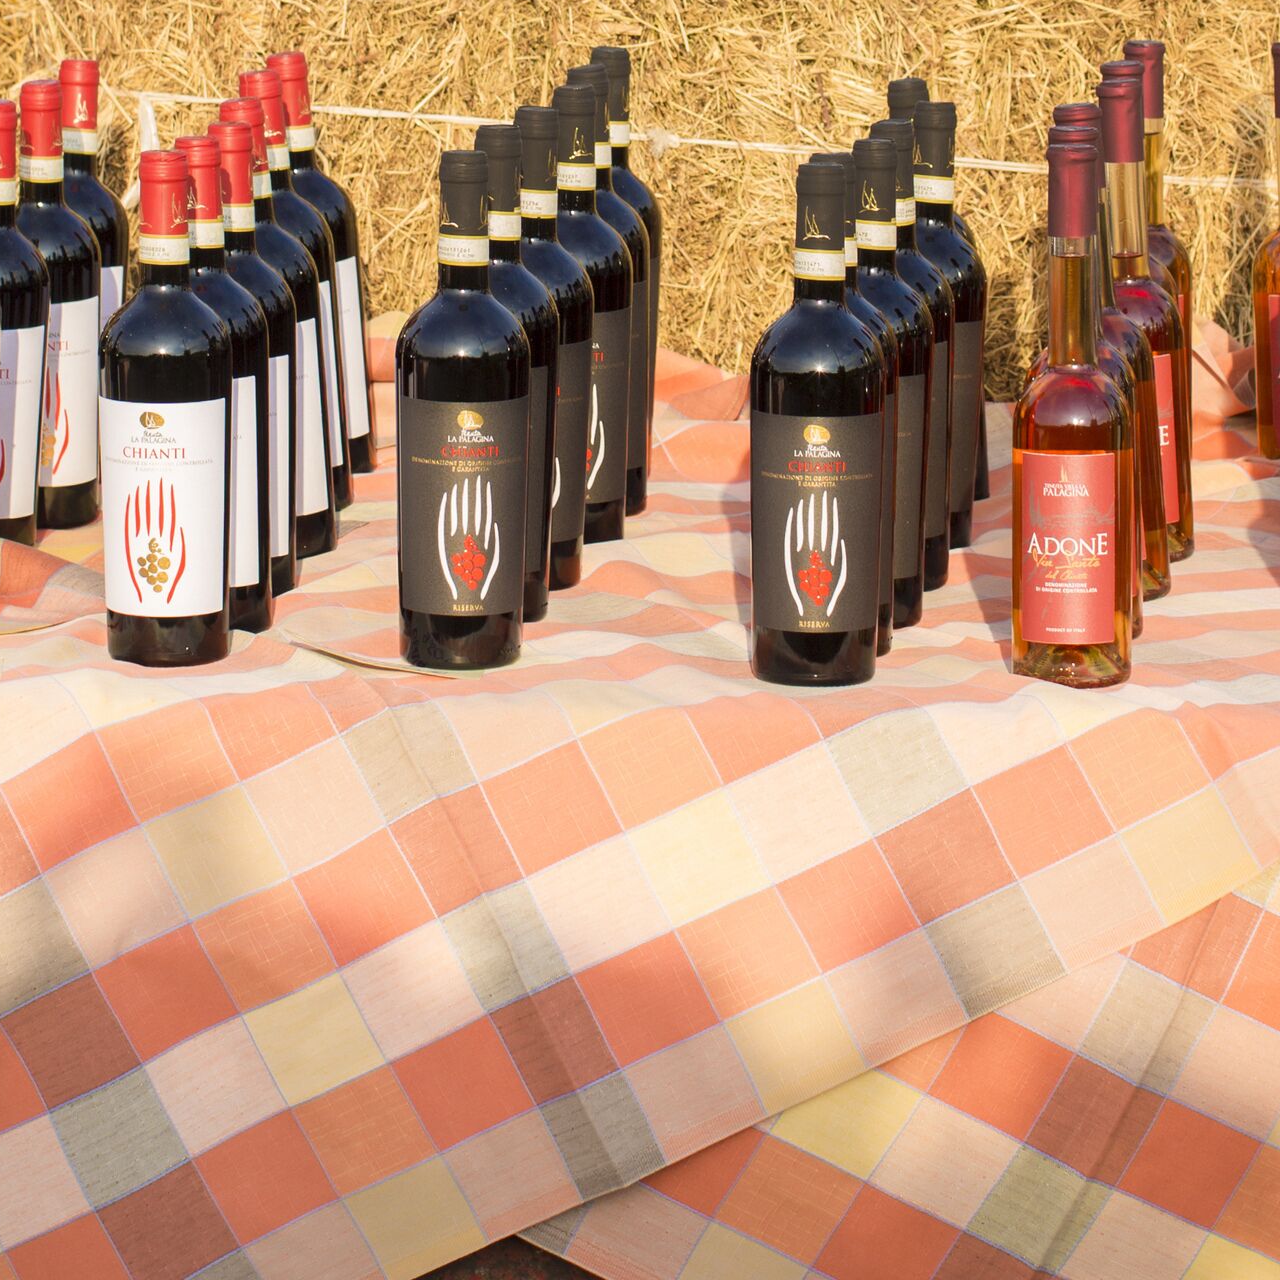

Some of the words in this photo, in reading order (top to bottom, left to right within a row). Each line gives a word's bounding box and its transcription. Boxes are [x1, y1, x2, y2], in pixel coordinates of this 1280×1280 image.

[141, 437, 177, 445] PALAGINA
[447, 435, 457, 443] LA
[122, 447, 186, 460] CHIANTI
[440, 446, 499, 458] CHIANTI
[793, 450, 804, 458] LA
[787, 461, 847, 474] CHIANTI
[1043, 488, 1090, 497] PALAGINA
[1027, 531, 1109, 557] ADONE
[1032, 548, 1054, 568] Vin
[1055, 549, 1101, 570] Santo
[452, 604, 484, 612] RISERVA
[798, 621, 831, 629] RISERVA
